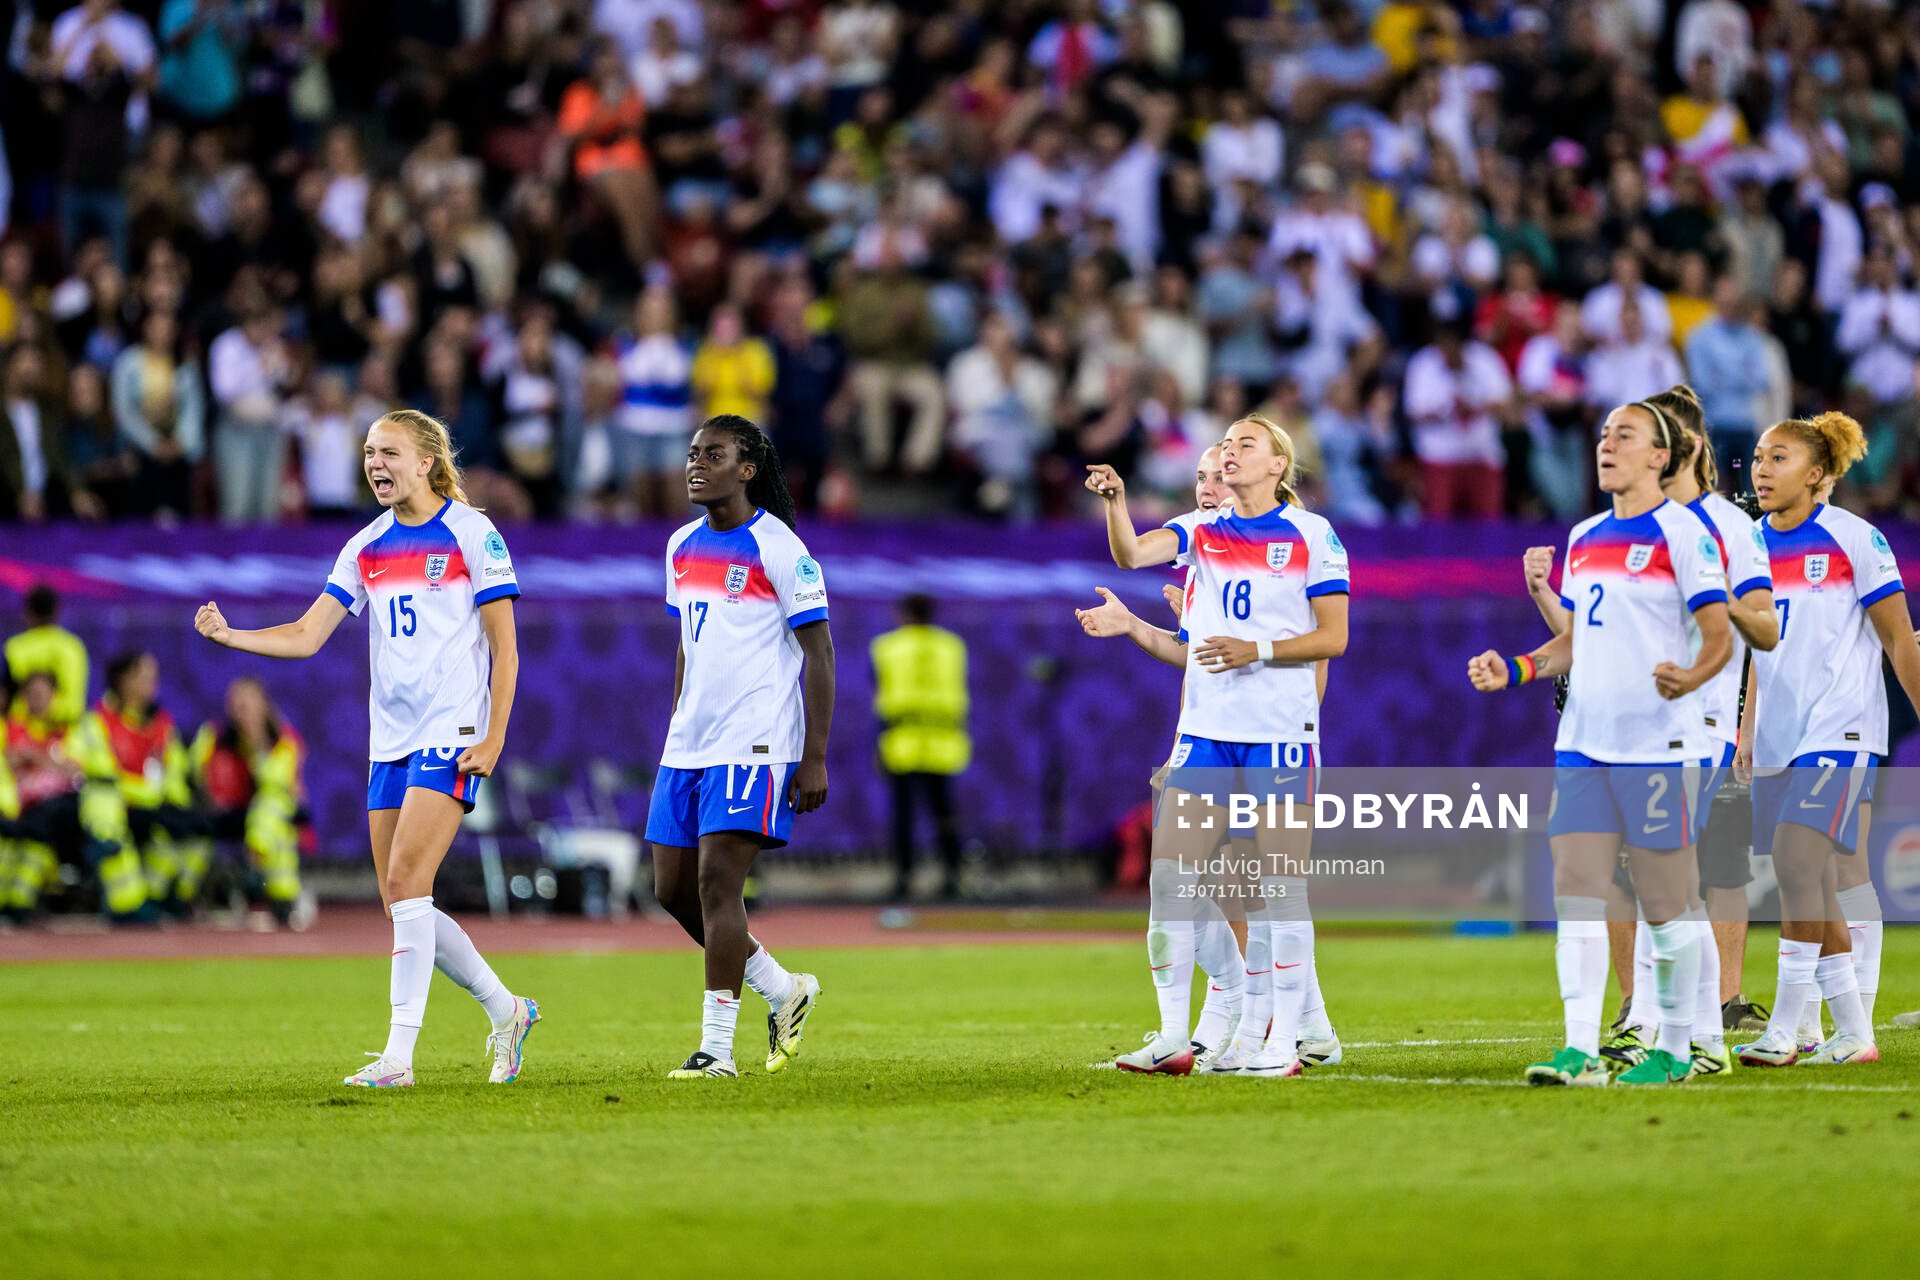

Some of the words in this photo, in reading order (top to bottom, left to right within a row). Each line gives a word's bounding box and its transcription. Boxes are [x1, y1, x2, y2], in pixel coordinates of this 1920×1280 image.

[389, 594, 417, 637] 15
[1222, 579, 1251, 620] 18
[1588, 583, 1604, 626] 2
[1774, 598, 1790, 640] 7
[688, 600, 709, 643] 17
[725, 764, 759, 800] 17
[1647, 772, 1668, 818] 2
[1810, 756, 1838, 796] 7
